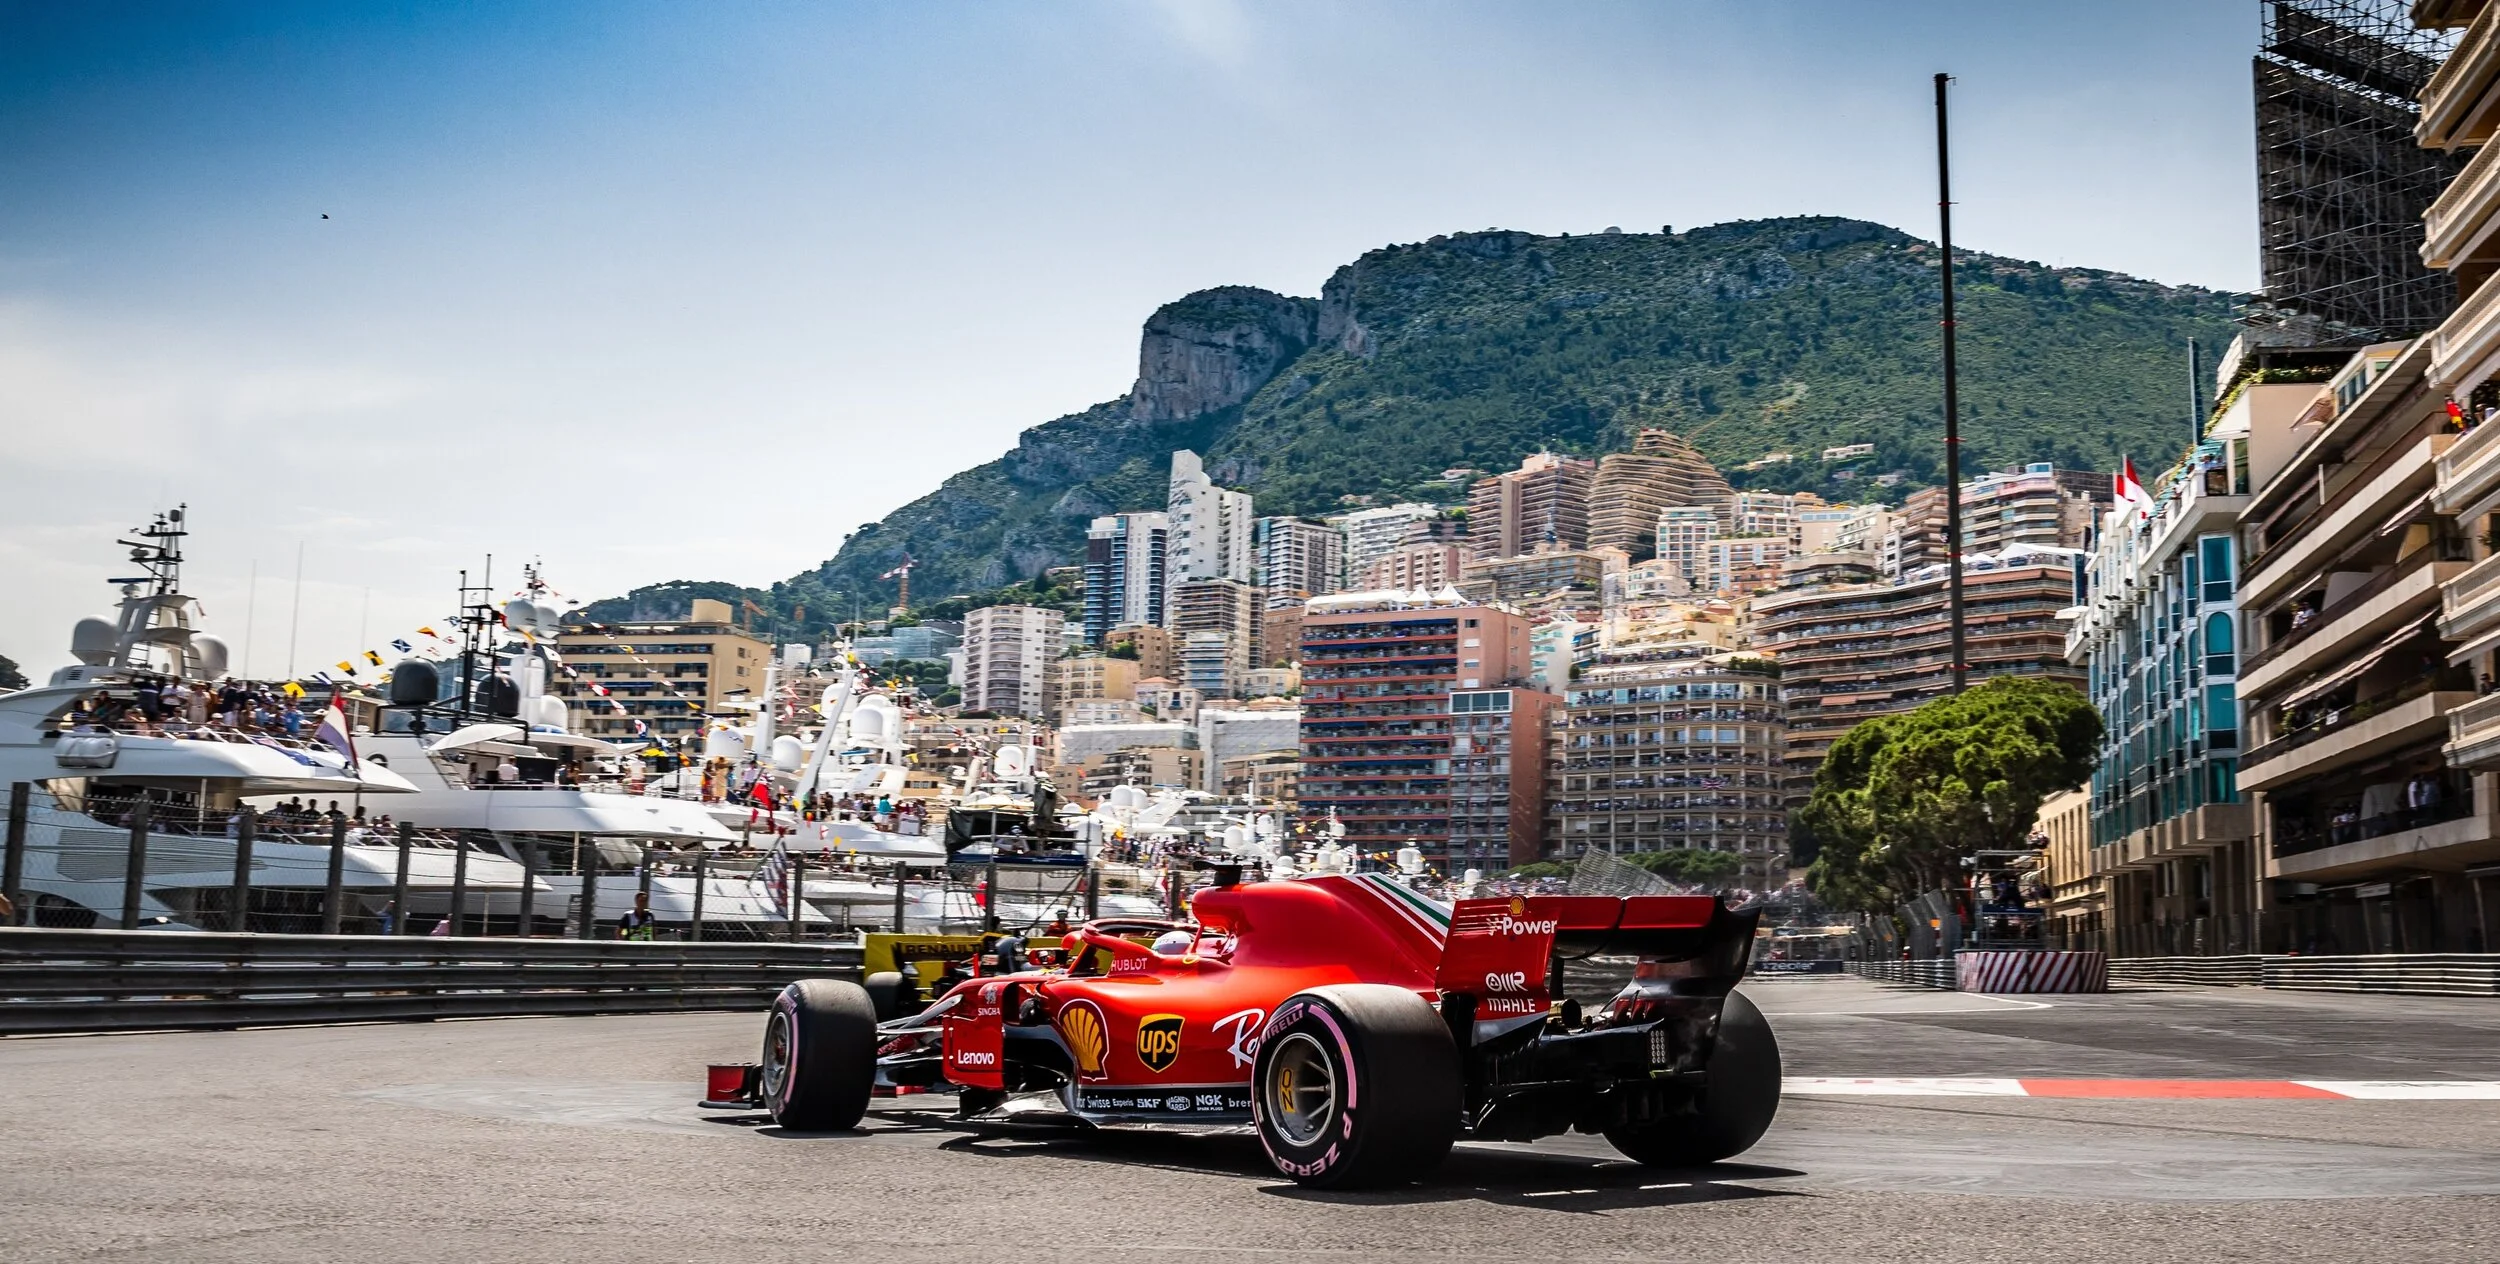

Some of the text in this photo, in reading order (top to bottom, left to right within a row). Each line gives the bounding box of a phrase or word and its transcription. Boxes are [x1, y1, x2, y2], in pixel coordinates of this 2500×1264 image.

[1110, 957, 1148, 972] HUBLOT
[977, 1007, 1001, 1016] SINGHA
[1487, 998, 1536, 1013] MAHLE
[1140, 1029, 1178, 1063] ups
[957, 1049, 995, 1065] Lenovo
[1137, 1098, 1161, 1109] SKF
[1195, 1094, 1222, 1106] NGK
[1278, 1141, 1340, 1177] ZERO
